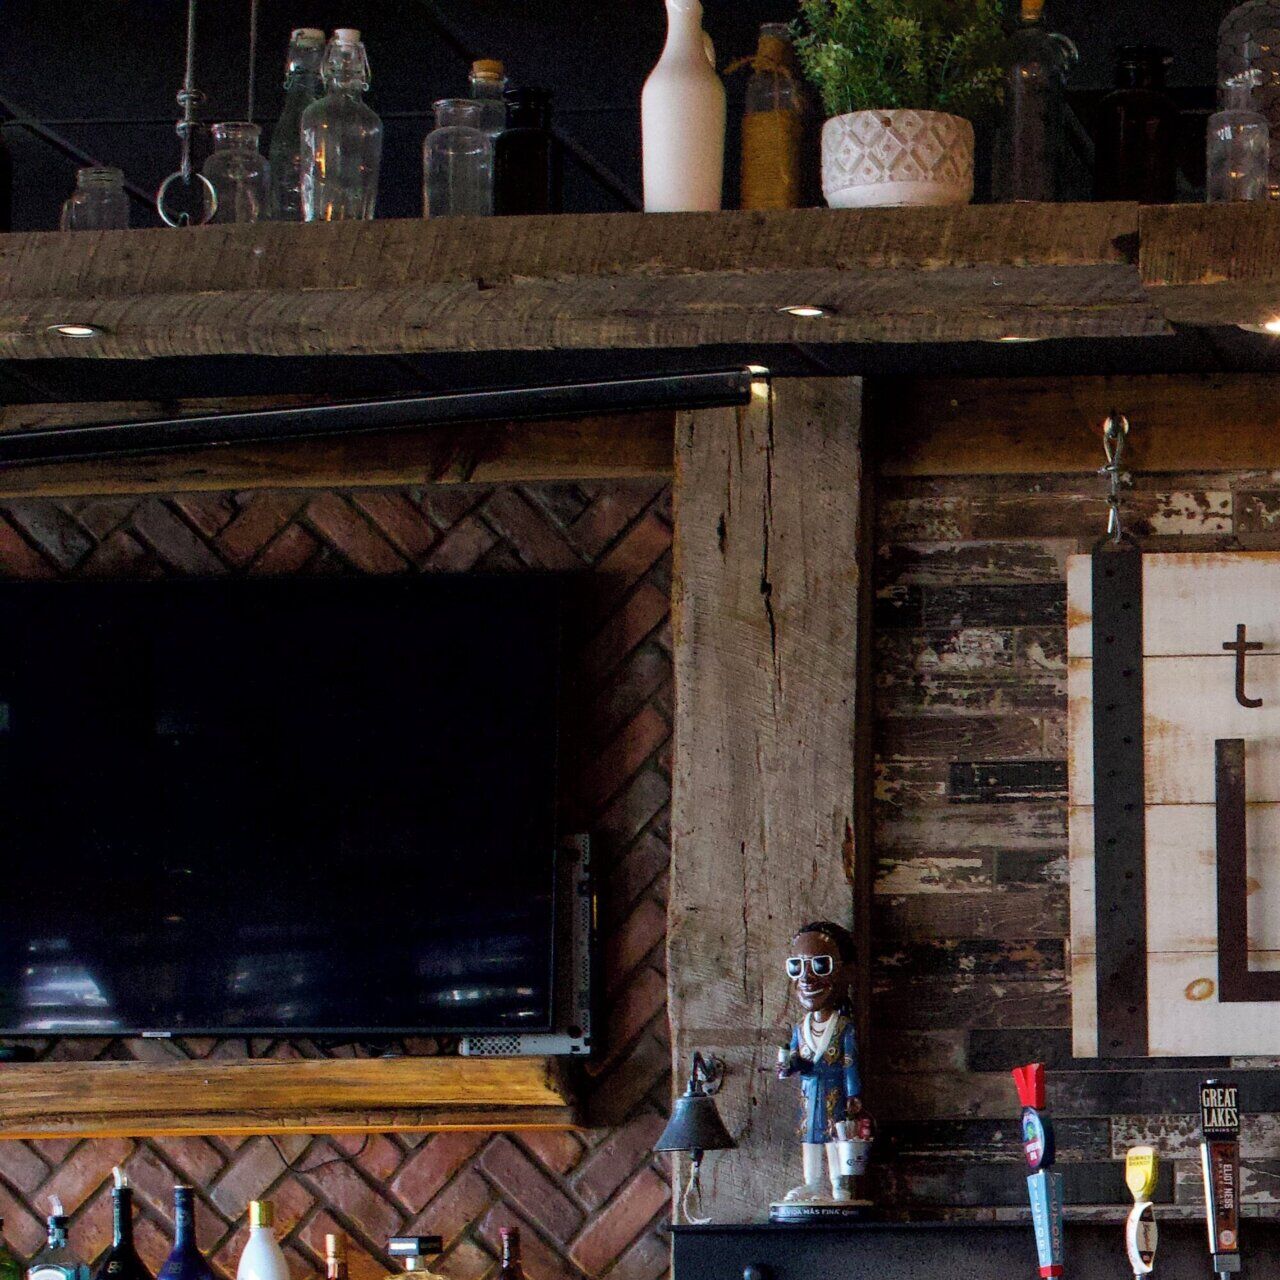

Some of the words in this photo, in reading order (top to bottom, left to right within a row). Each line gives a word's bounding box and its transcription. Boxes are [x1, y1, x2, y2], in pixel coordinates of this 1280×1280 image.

[1202, 1088, 1237, 1108] GREAT
[1203, 1108, 1239, 1127] LAKES
[1223, 1163, 1232, 1186] ELIOT
[1223, 1187, 1233, 1209] NESS
[1032, 1180, 1046, 1259] VICTORY
[1050, 1175, 1060, 1260] VICTORY
